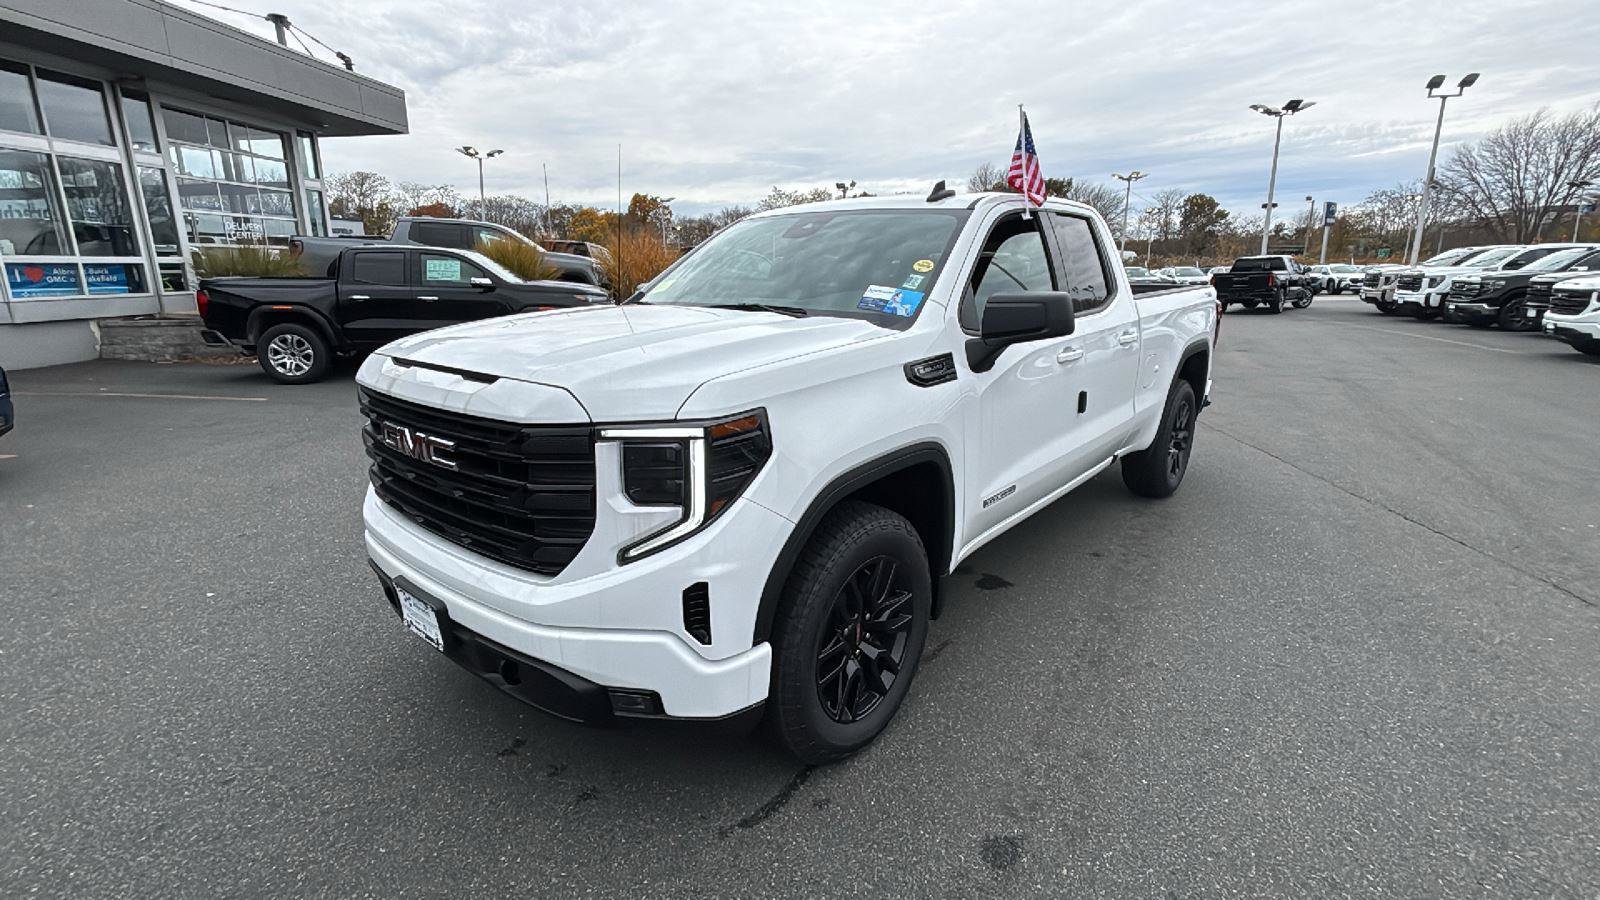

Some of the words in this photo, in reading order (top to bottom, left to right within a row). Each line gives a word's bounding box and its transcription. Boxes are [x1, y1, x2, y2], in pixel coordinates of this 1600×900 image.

[225, 221, 263, 231] DELIVERY
[231, 231, 262, 240] CENTER
[46, 275, 67, 283] GMC
[383, 421, 459, 472] GMC
